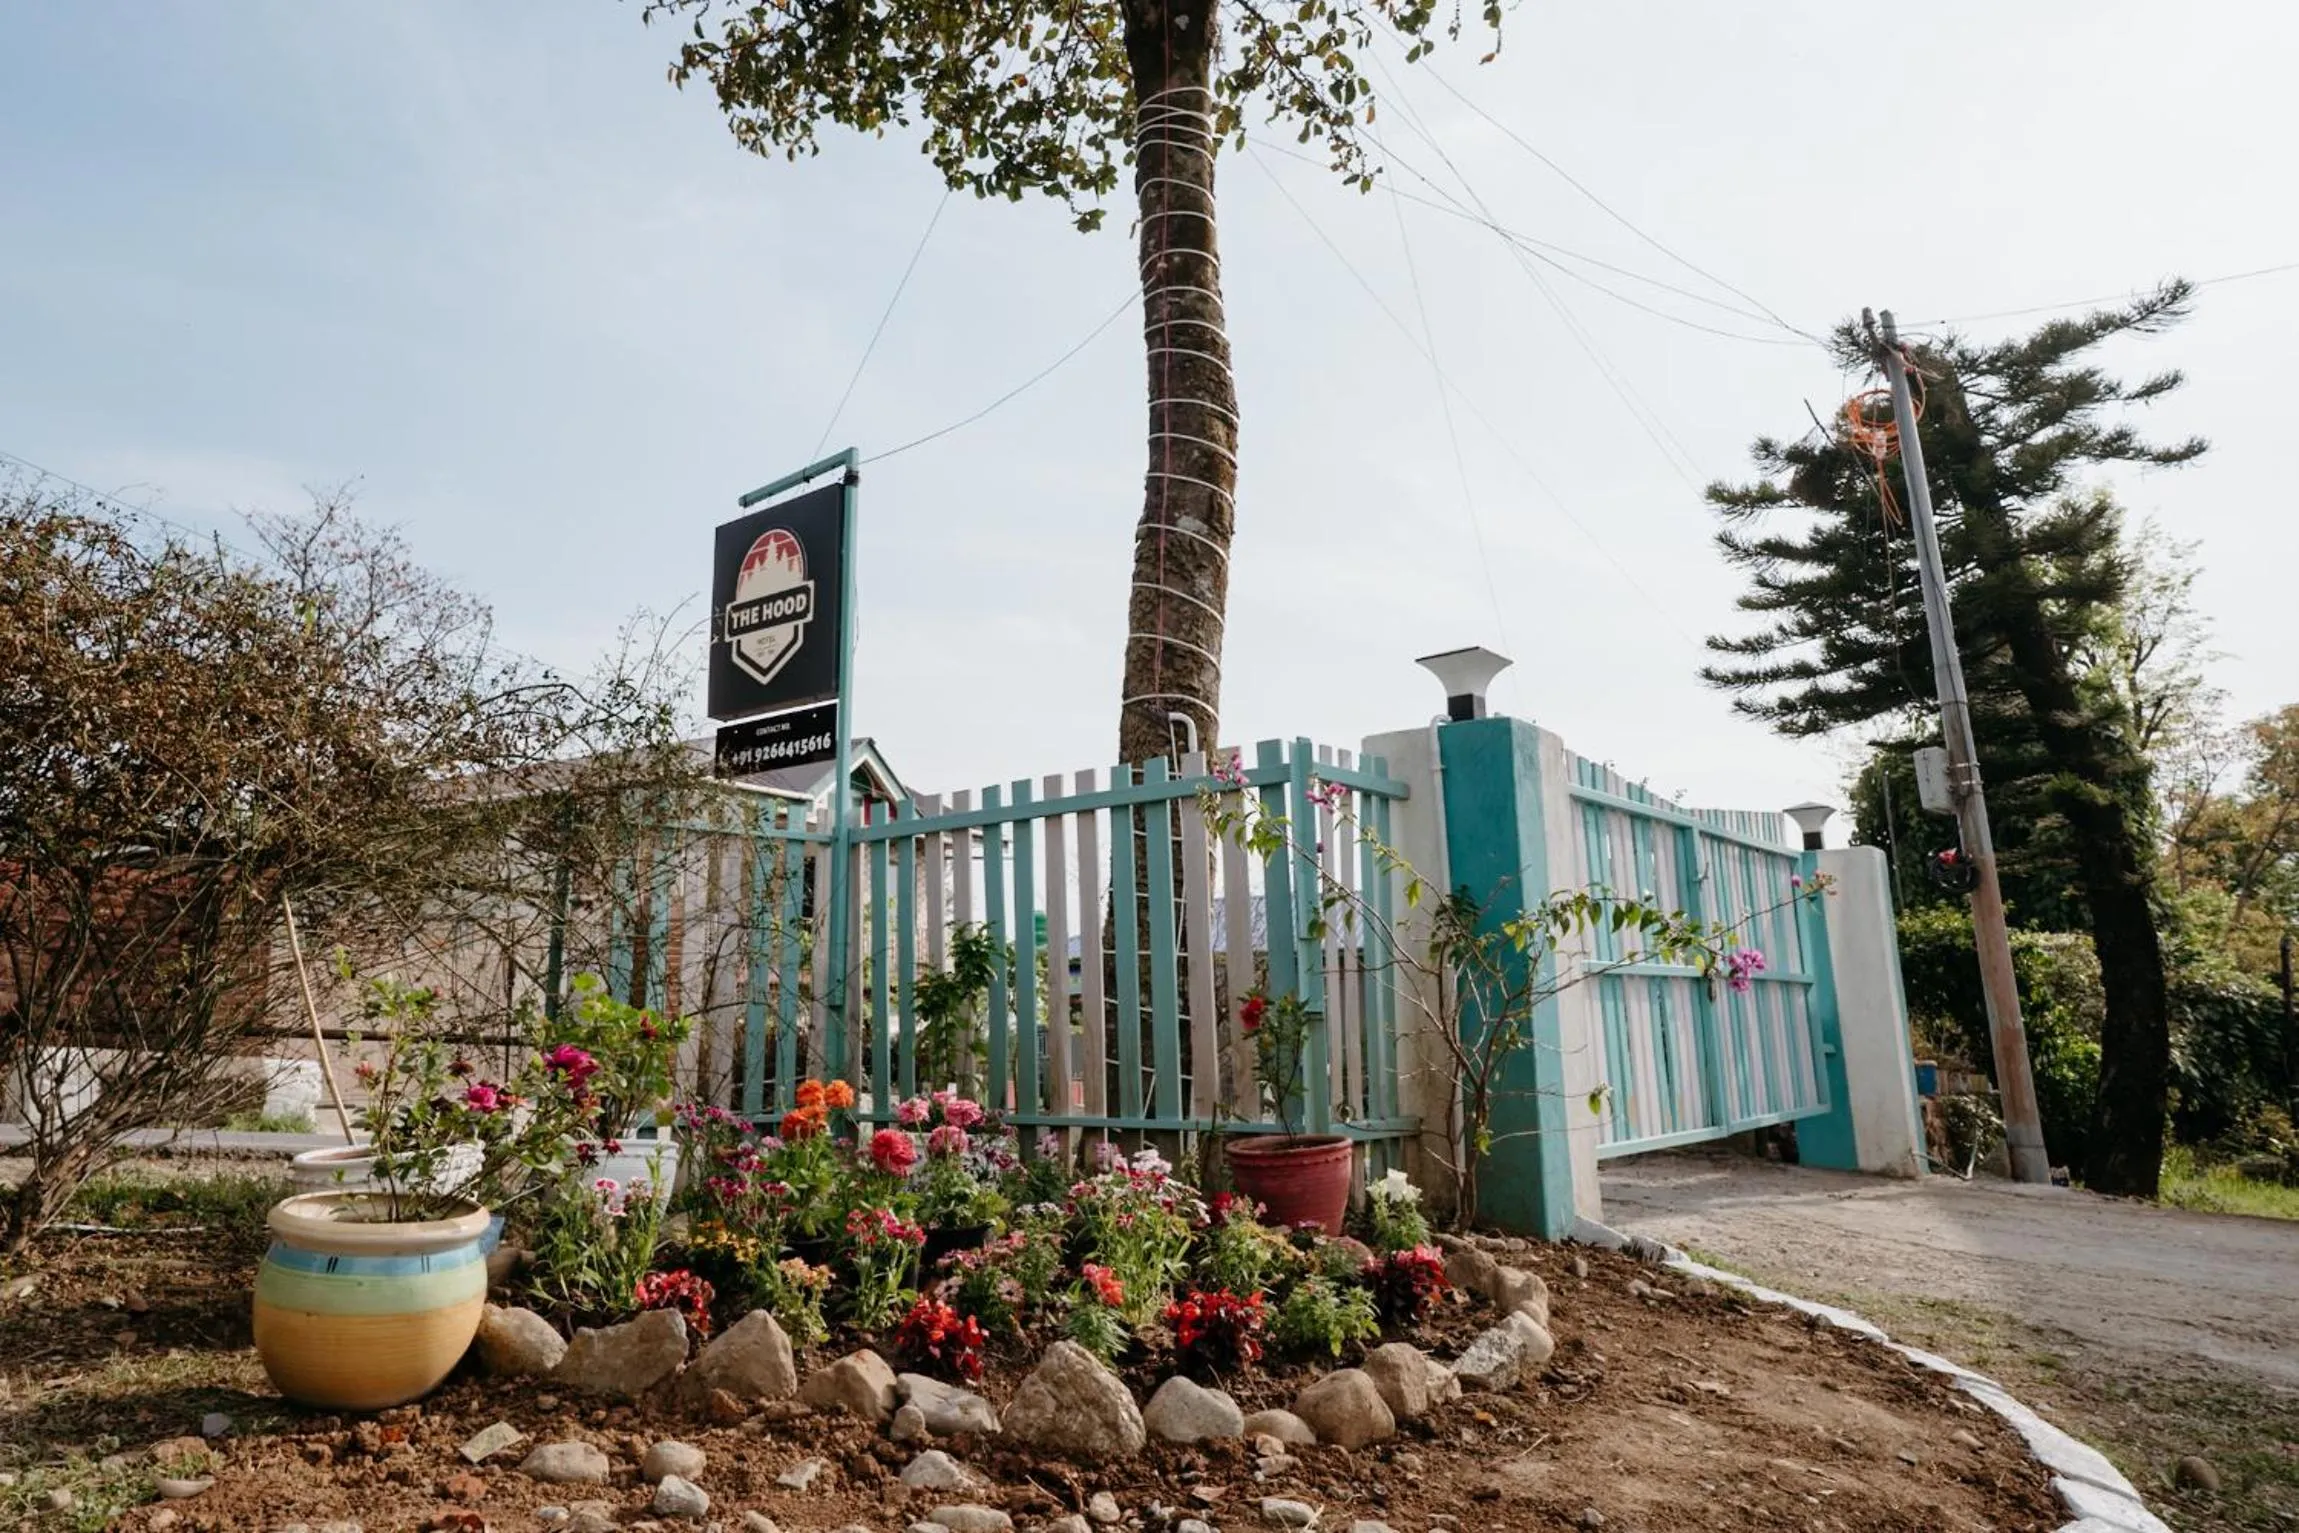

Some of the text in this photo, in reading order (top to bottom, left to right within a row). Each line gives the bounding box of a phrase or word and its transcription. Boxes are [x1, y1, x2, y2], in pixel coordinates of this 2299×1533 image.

[731, 593, 807, 630] THE HOOD
[755, 732, 831, 763] 9266415616
